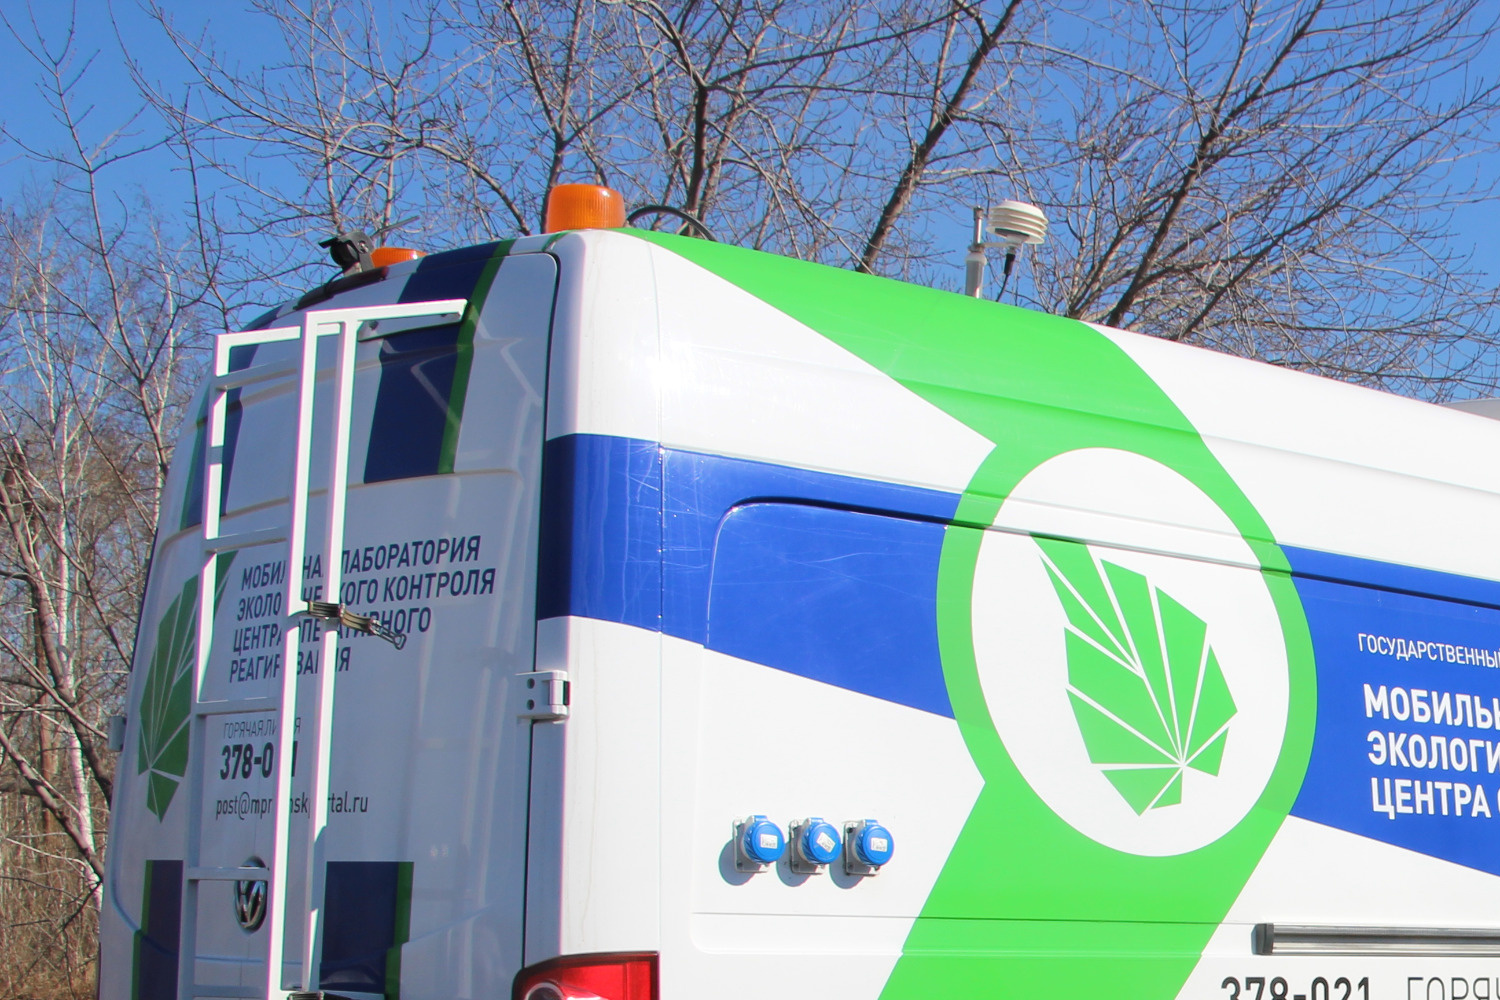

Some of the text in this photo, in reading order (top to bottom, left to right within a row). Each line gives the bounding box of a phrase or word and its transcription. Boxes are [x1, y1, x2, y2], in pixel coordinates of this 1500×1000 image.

[241, 535, 481, 591] МОБИНА ЛАБОРАТОРИЯ
[237, 568, 496, 621] ЭКОЛОЧЕОГО КОНТРОЛЯ
[229, 646, 351, 683] РЕАГИРВАЯ
[223, 720, 263, 739] ГОРЯЧАЯ
[220, 741, 298, 780] 378-01
[216, 791, 369, 820] post@mprsktal.ru
[1371, 777, 1491, 820] ЦЕНТРА
